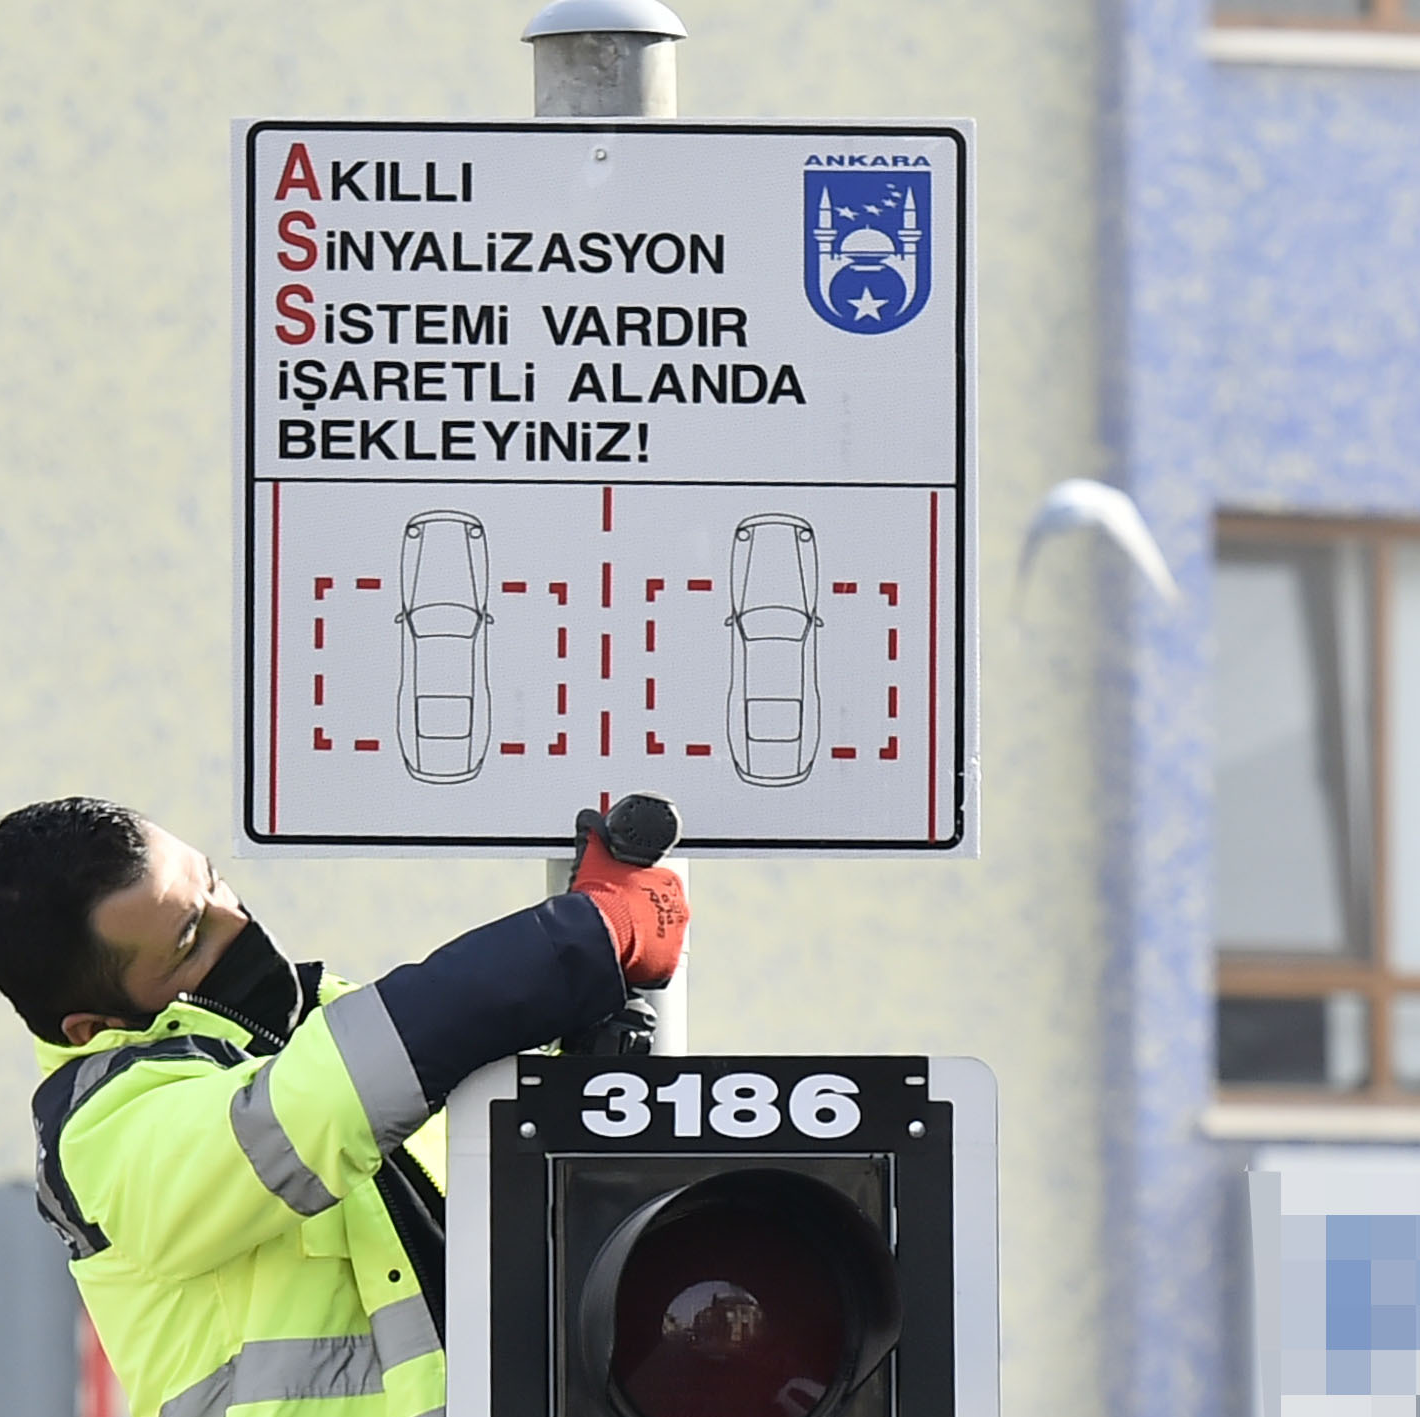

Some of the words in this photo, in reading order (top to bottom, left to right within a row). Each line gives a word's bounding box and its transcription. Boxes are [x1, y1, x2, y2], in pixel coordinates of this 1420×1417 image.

[274, 142, 473, 203] AKILLI
[804, 154, 931, 167] ANKARA
[541, 305, 749, 348] VARDIR
[567, 362, 808, 406] ALANDA
[581, 1072, 862, 1139] 3186
